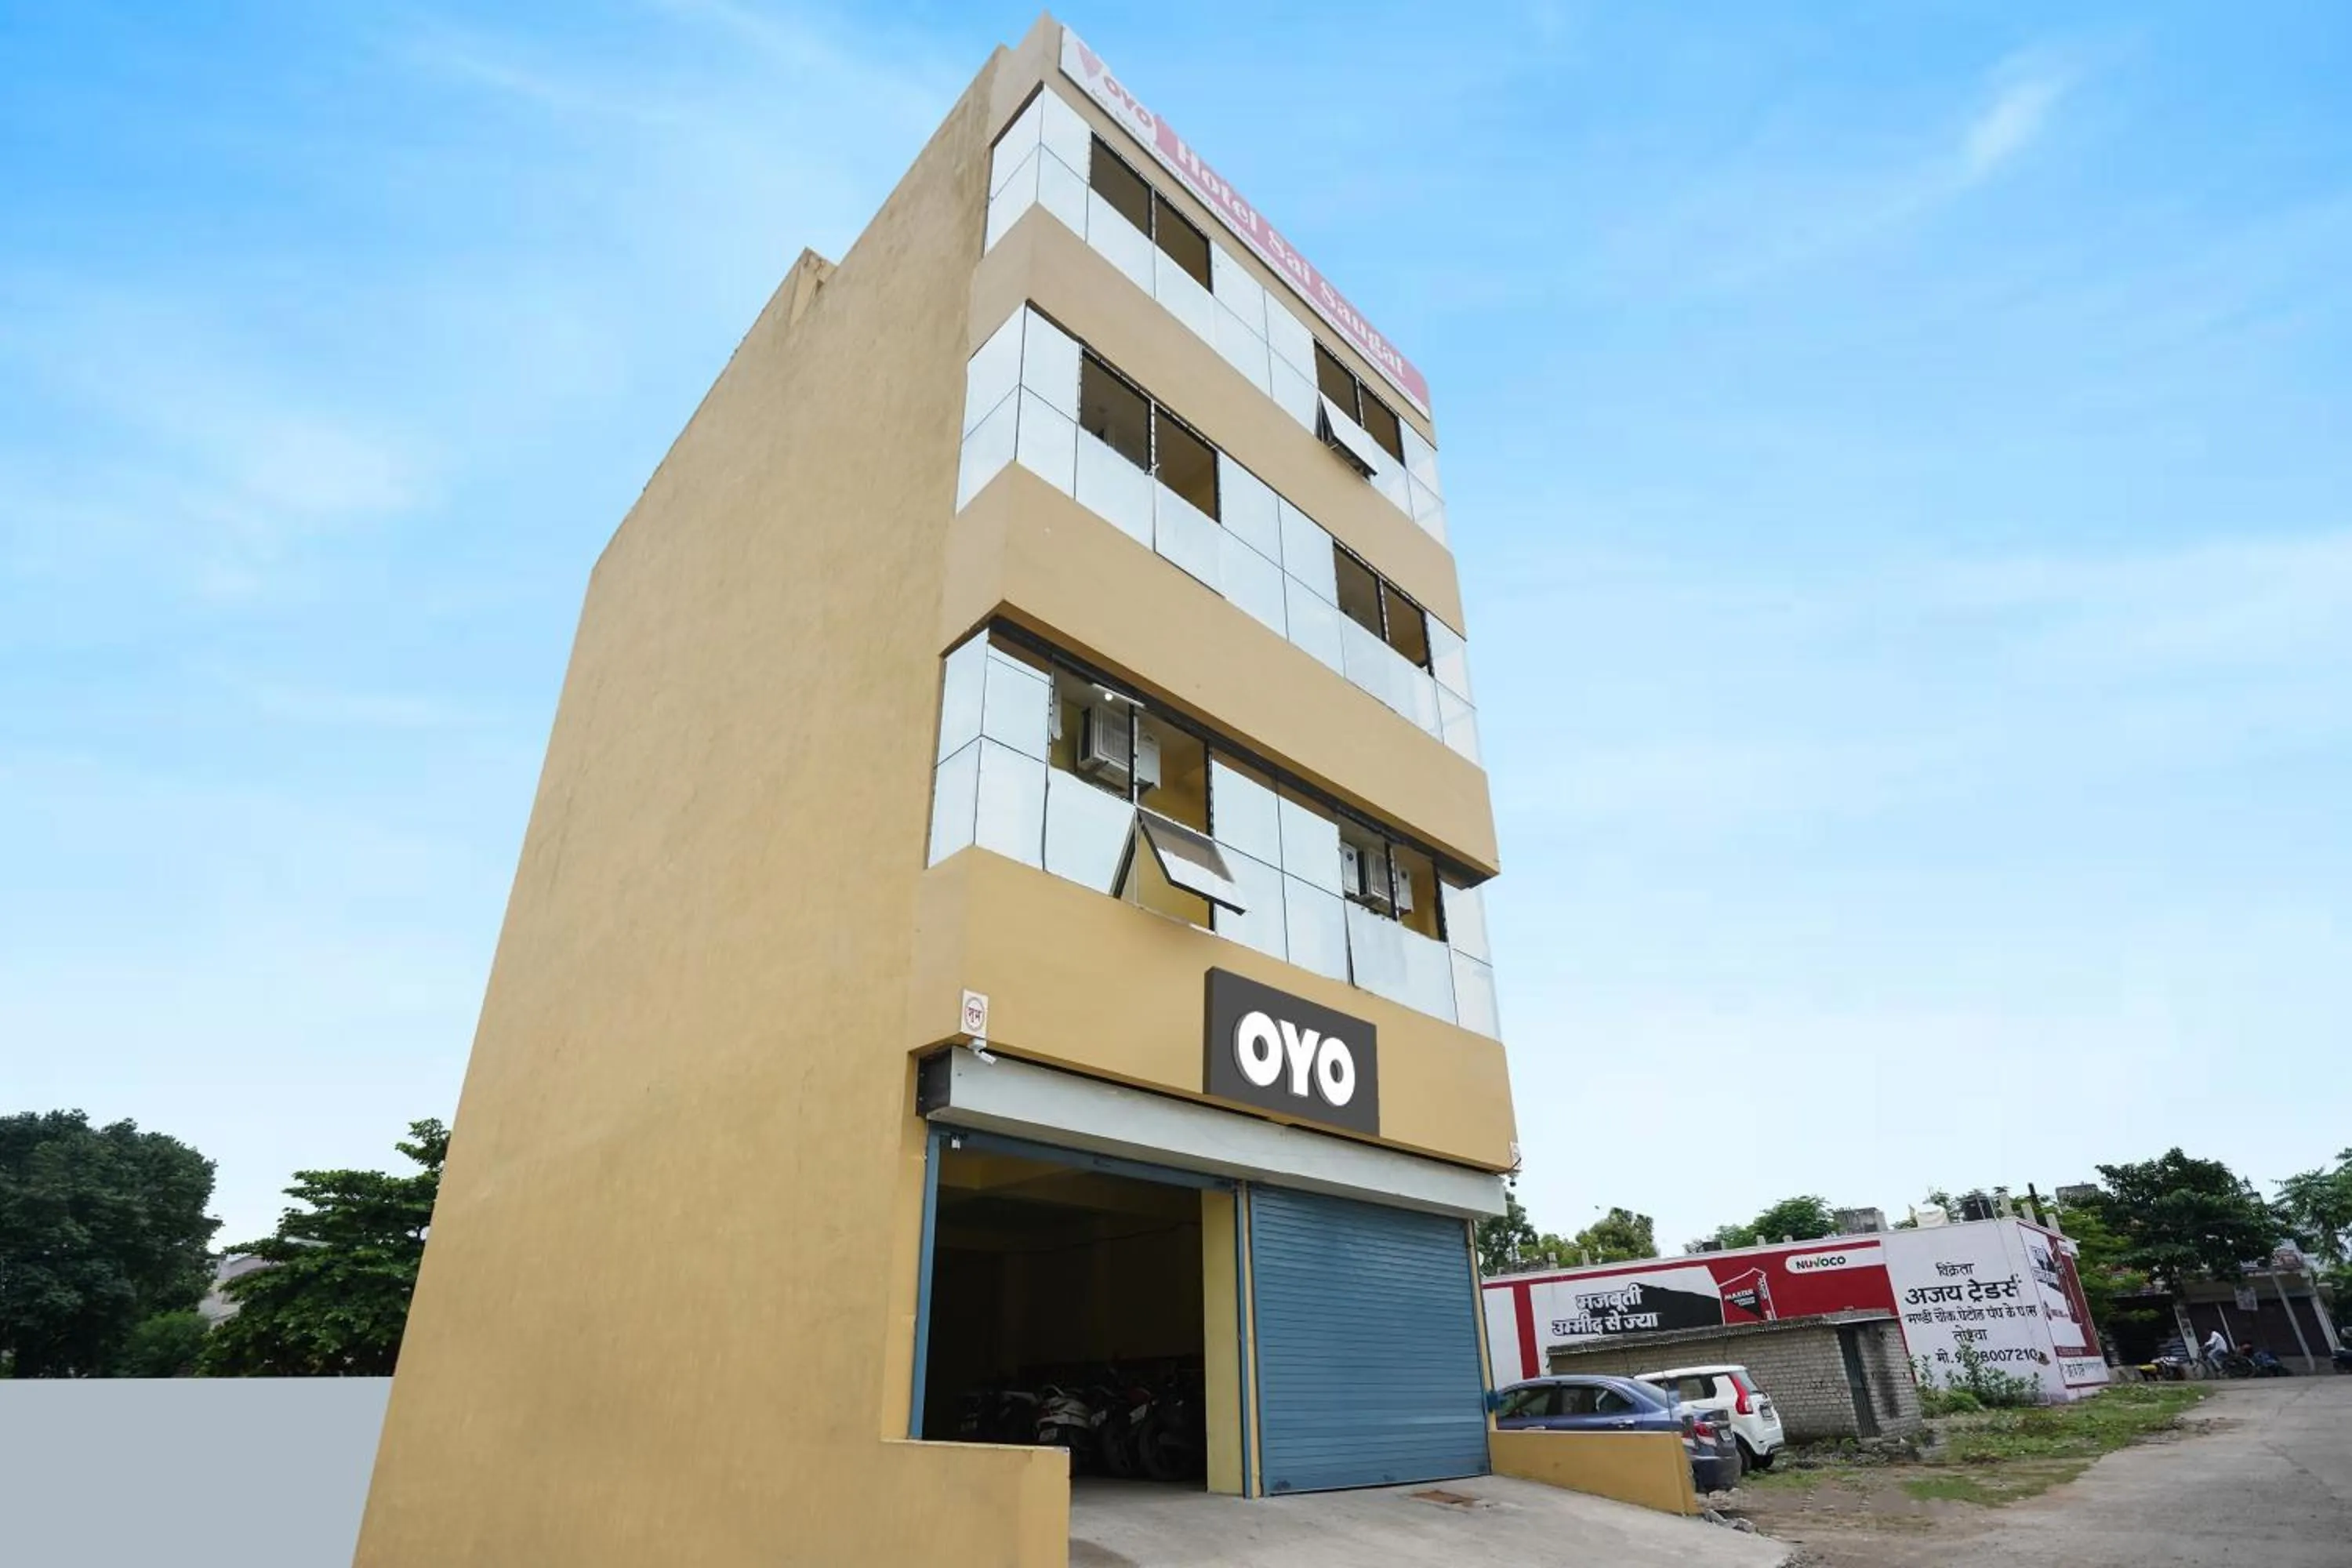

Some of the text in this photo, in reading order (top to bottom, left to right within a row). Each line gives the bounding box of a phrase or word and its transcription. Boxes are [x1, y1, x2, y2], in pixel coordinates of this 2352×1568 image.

[1103, 75, 1152, 129] OYO
[1177, 137, 1258, 232] Hotel
[1268, 229, 1311, 287] Sai
[1233, 1011, 1356, 1106] OYO
[1795, 1256, 1846, 1269] NUVOCO
[1904, 1285, 1963, 1305] अजय
[1604, 1310, 1622, 1330] से
